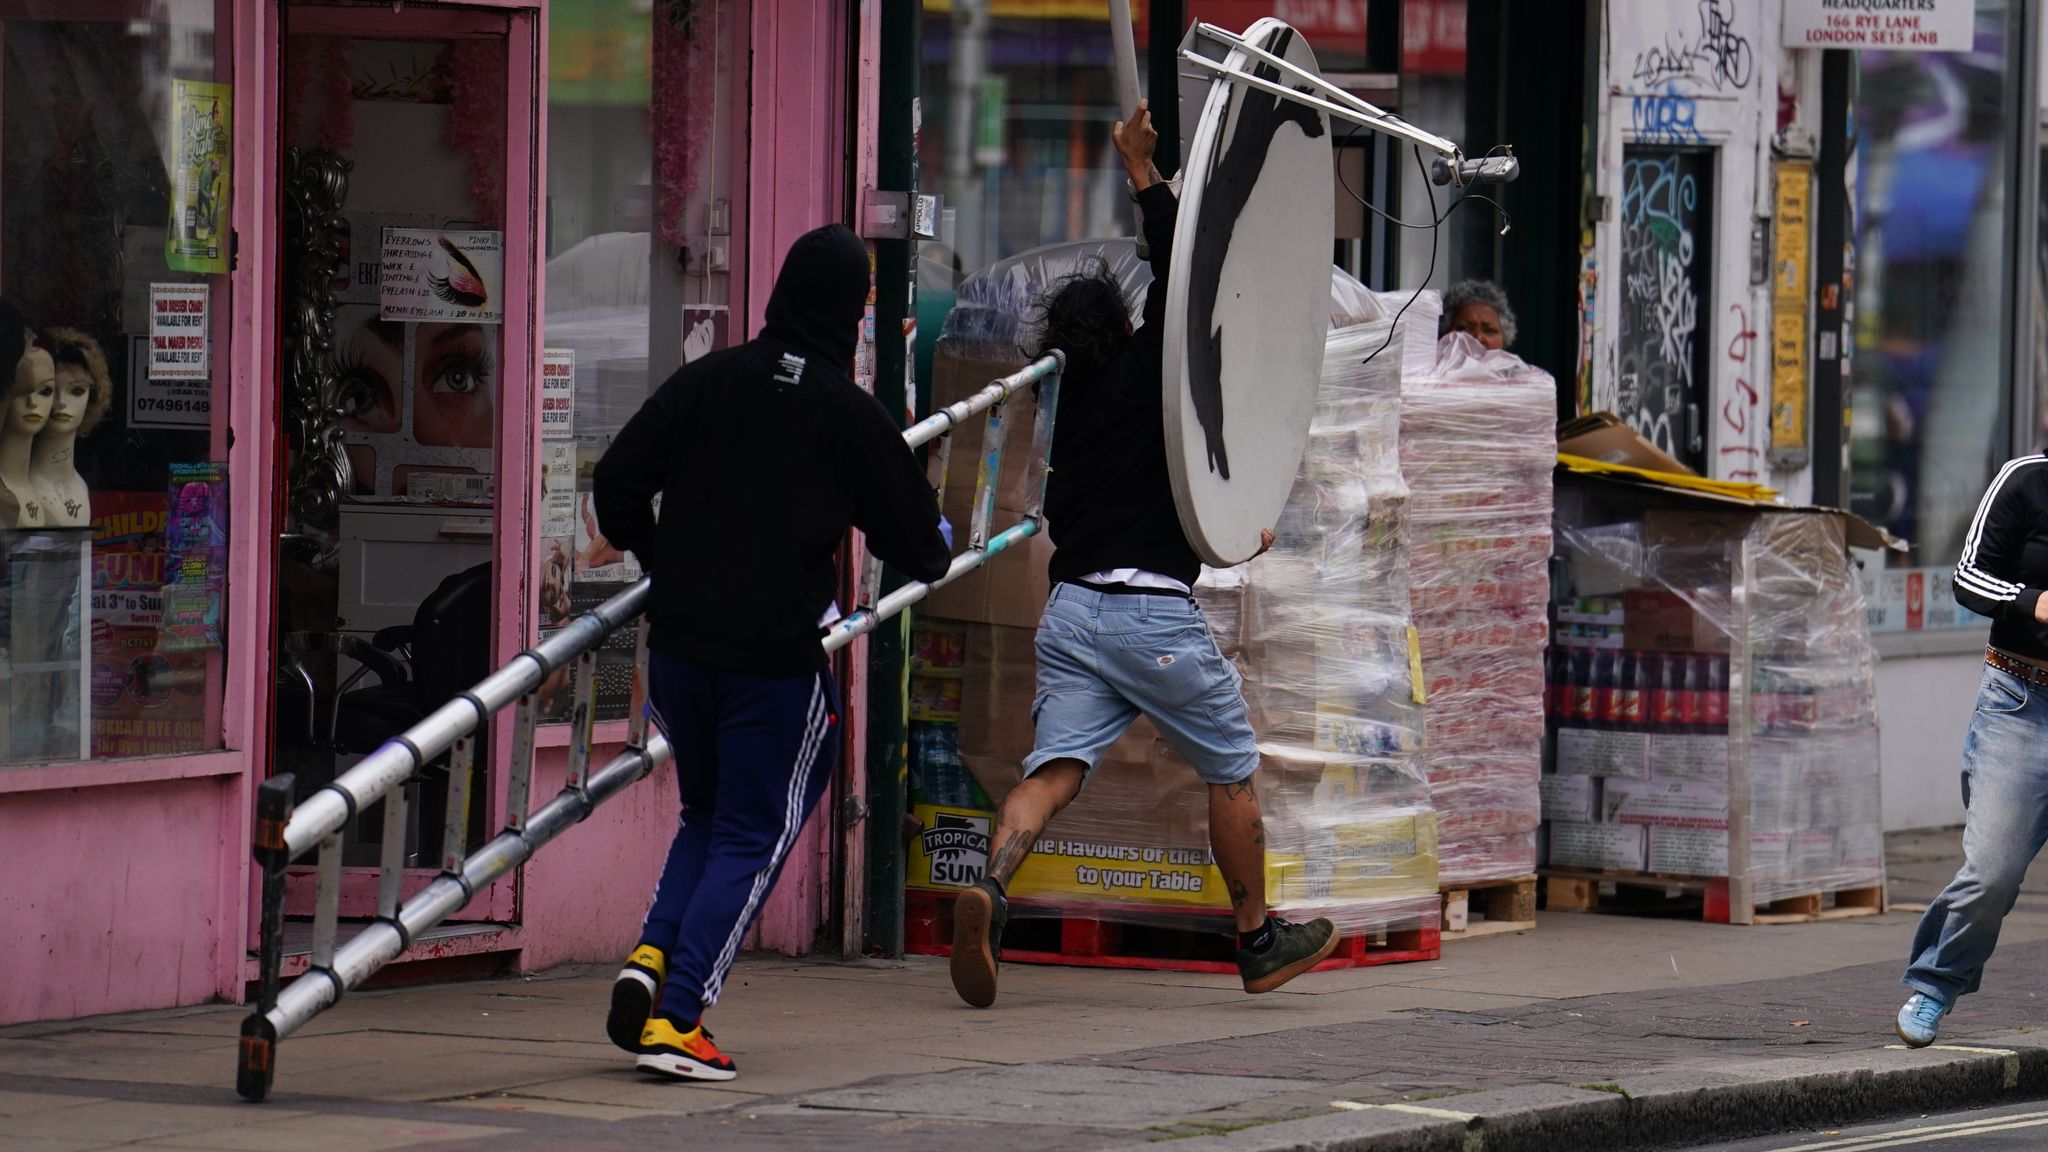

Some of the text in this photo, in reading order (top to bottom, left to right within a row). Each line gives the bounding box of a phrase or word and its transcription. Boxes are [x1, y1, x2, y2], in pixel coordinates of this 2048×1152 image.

[1822, 0, 1935, 11] HEADQUARTERS
[1827, 15, 1921, 29] 166 RYE LANE
[1806, 29, 1938, 44] LONDON SE15 4NB
[138, 399, 210, 413] 07496149
[92, 512, 168, 540] CHILD
[92, 595, 106, 609] at
[925, 832, 988, 852] TROPICA
[1032, 839, 1055, 854] he
[934, 861, 982, 884] SUN
[1076, 864, 1203, 892] to your Table
